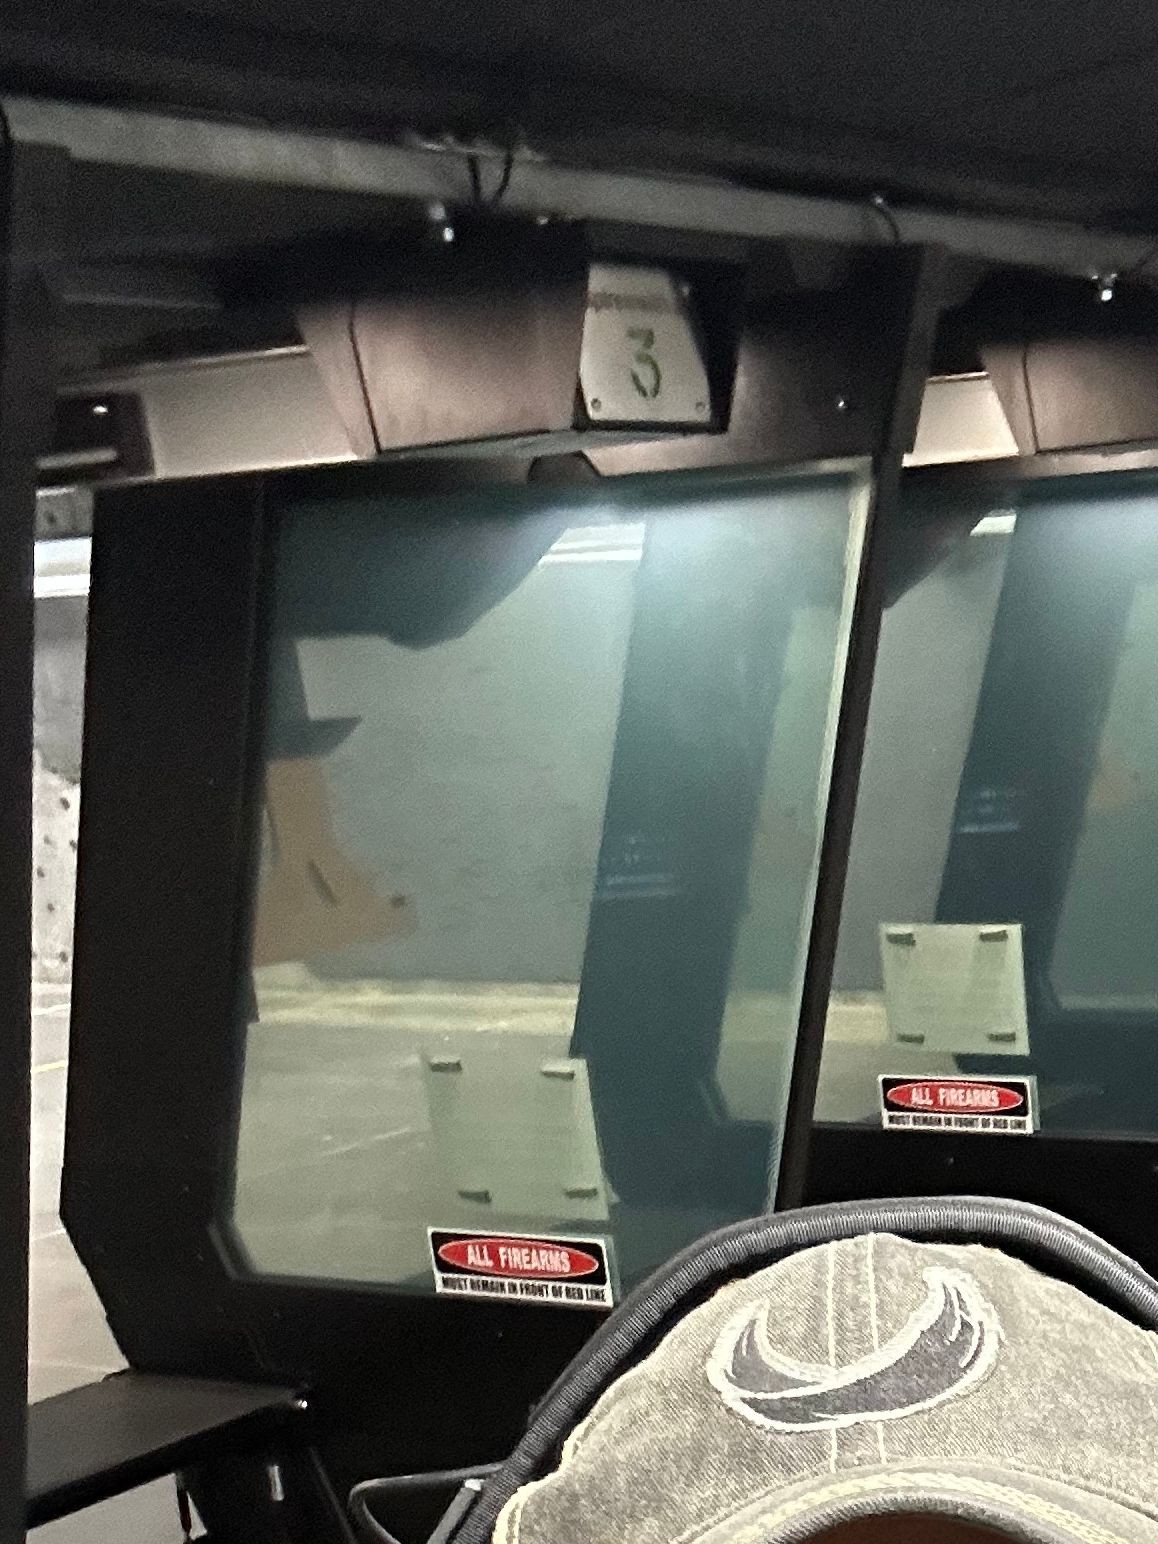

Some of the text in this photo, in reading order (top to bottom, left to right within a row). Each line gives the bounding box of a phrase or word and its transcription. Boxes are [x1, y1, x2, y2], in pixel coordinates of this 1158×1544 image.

[627, 328, 662, 398] 3
[911, 1087, 1000, 1107] ALL FIREARMS
[466, 1244, 572, 1273] ALL FIREARMS
[441, 1276, 607, 1302] MUST REMAIN IN FRONT OF RED LINE
